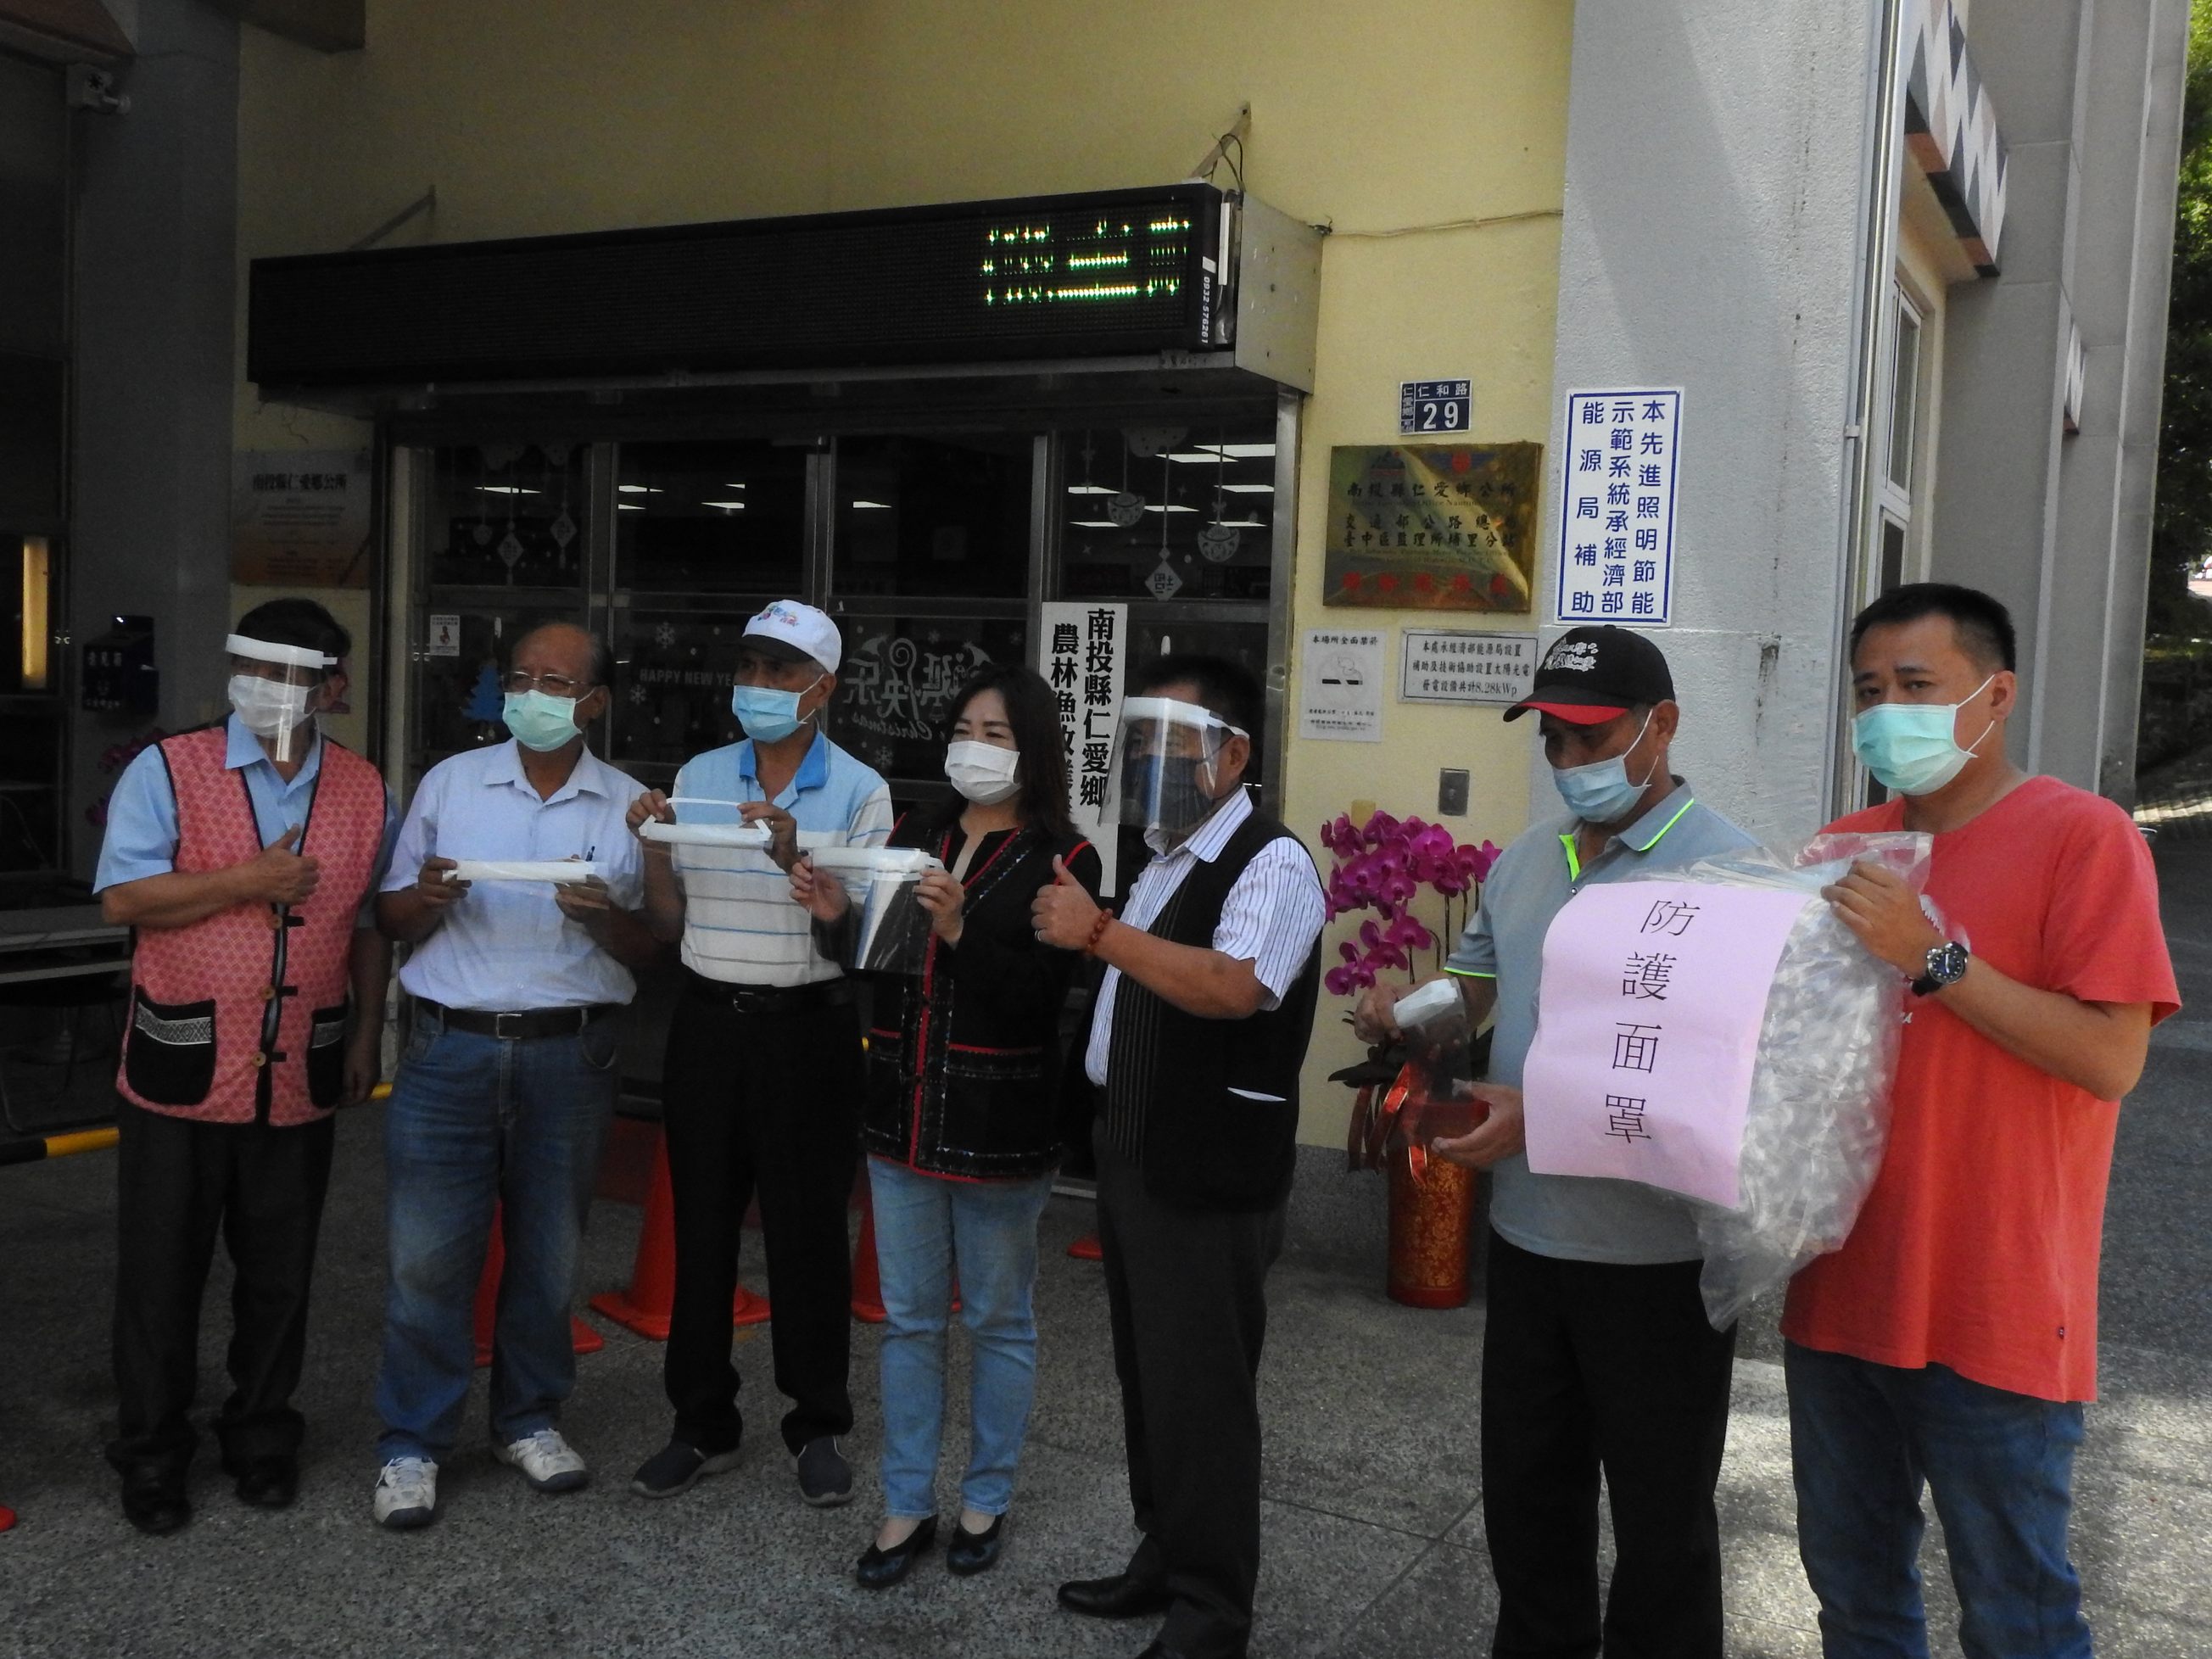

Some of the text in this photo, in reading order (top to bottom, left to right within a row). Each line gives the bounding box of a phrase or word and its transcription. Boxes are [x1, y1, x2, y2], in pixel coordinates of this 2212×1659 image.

[1417, 383, 1467, 397] 仁和路
[1423, 401, 1459, 429] 29
[1572, 401, 1604, 613] 能源局補助
[1601, 400, 1635, 614] 示範系統承經濟部
[1631, 399, 1665, 615] 本先進照明節能
[640, 668, 681, 684] HAPPY
[684, 671, 714, 685] NEW
[1051, 623, 1080, 814] 農林漁
[1080, 607, 1115, 807] 南投縣仁愛鄉
[1313, 635, 1378, 645] 本場所全面禁菸
[1604, 899, 1701, 1144] 防護面罩
